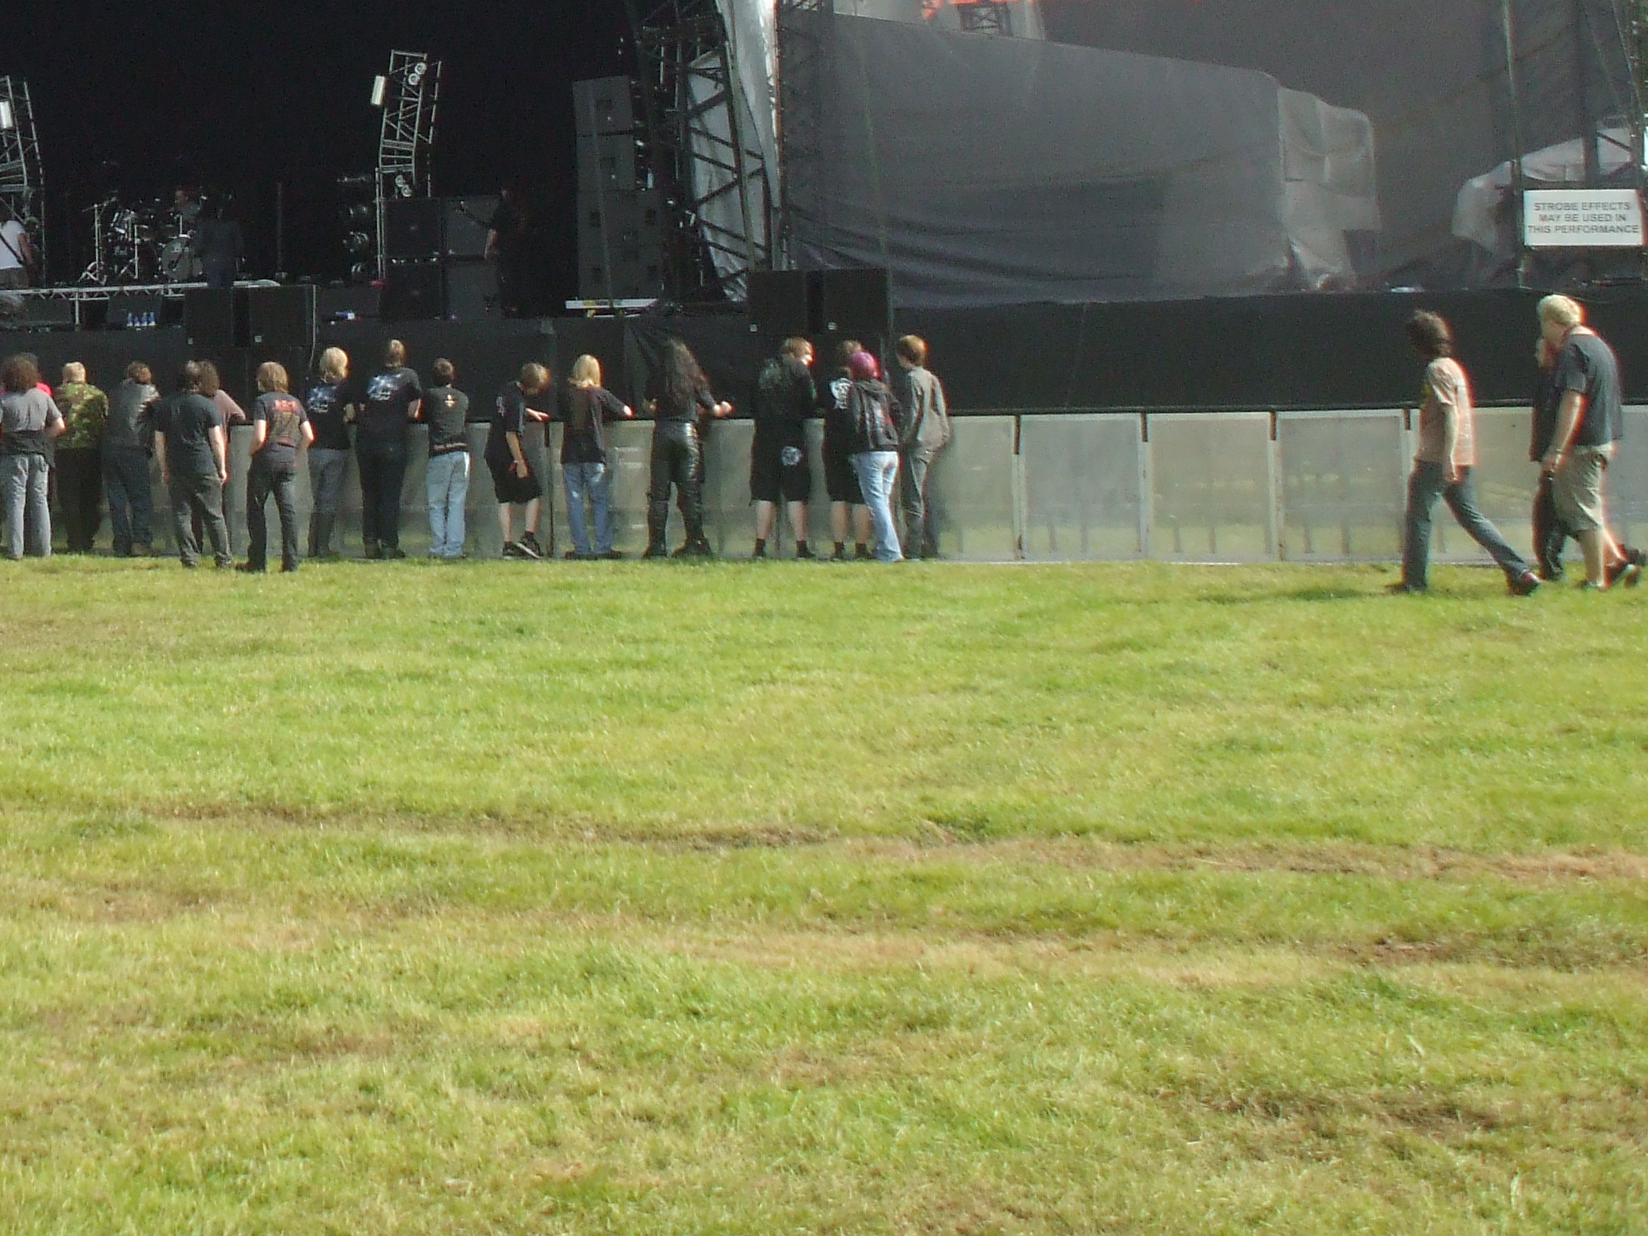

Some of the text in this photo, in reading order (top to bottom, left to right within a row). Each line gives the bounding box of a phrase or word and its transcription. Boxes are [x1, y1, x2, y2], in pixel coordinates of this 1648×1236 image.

[1533, 202, 1631, 211] STROBE EFFECTS
[1538, 213, 1627, 222] MAY BE USED IN
[1527, 225, 1640, 234] THIS PERFORMANCE
